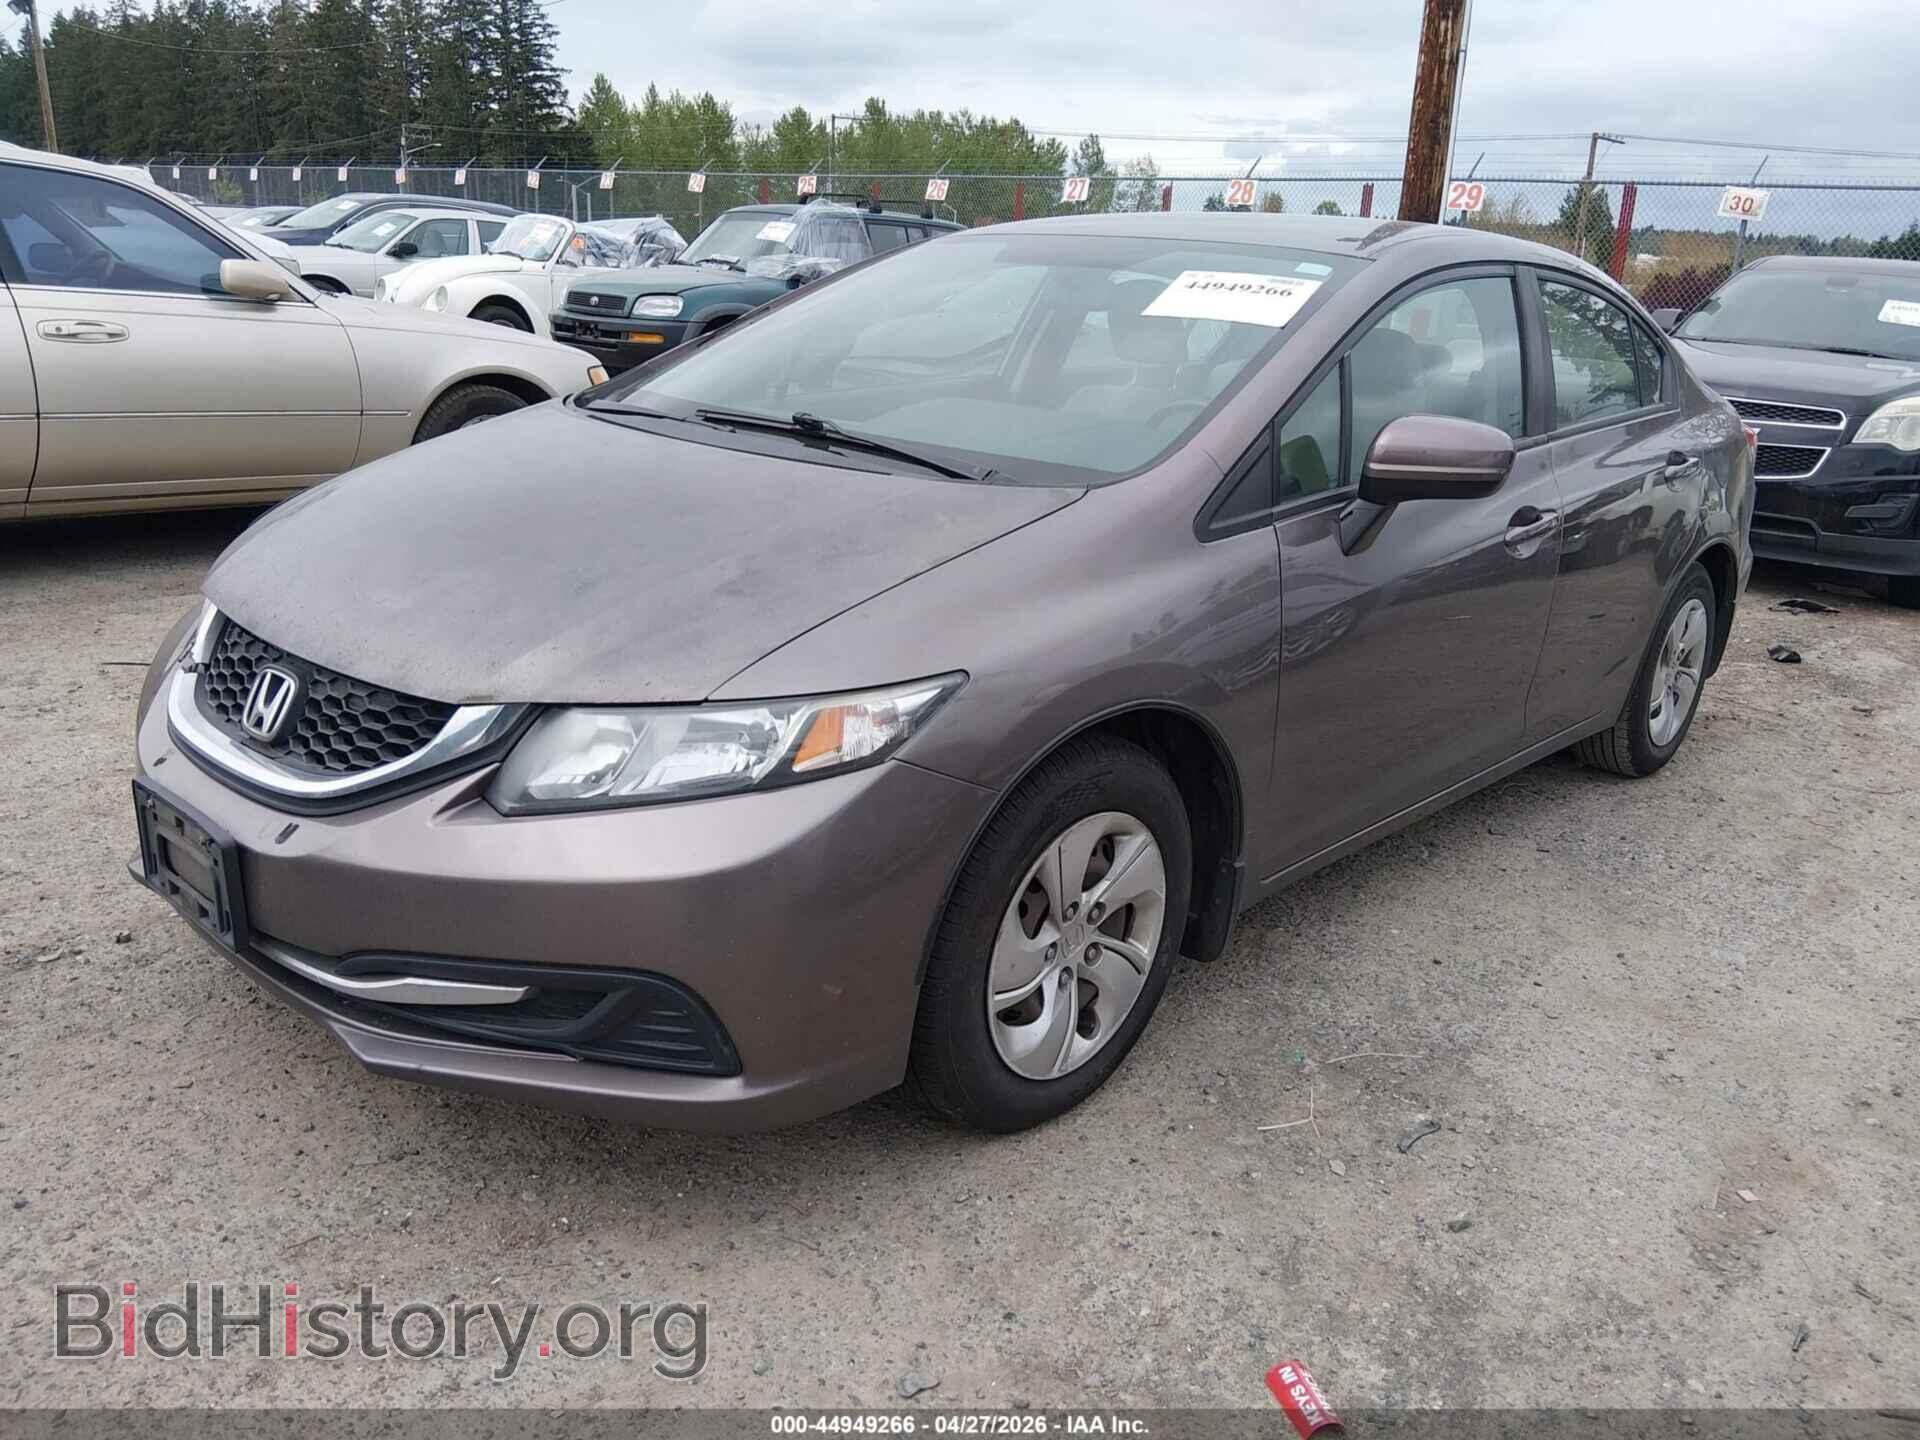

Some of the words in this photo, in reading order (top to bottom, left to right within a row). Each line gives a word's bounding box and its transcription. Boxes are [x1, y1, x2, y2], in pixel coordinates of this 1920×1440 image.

[800, 177, 815, 193] 25
[928, 180, 947, 199] 26
[1066, 178, 1088, 200] 27
[1228, 180, 1255, 203] 28
[1448, 183, 1483, 209] 29
[1729, 195, 1754, 213] 30
[1278, 1365, 1299, 1385] IN
[1290, 1384, 1324, 1426] KEYS
